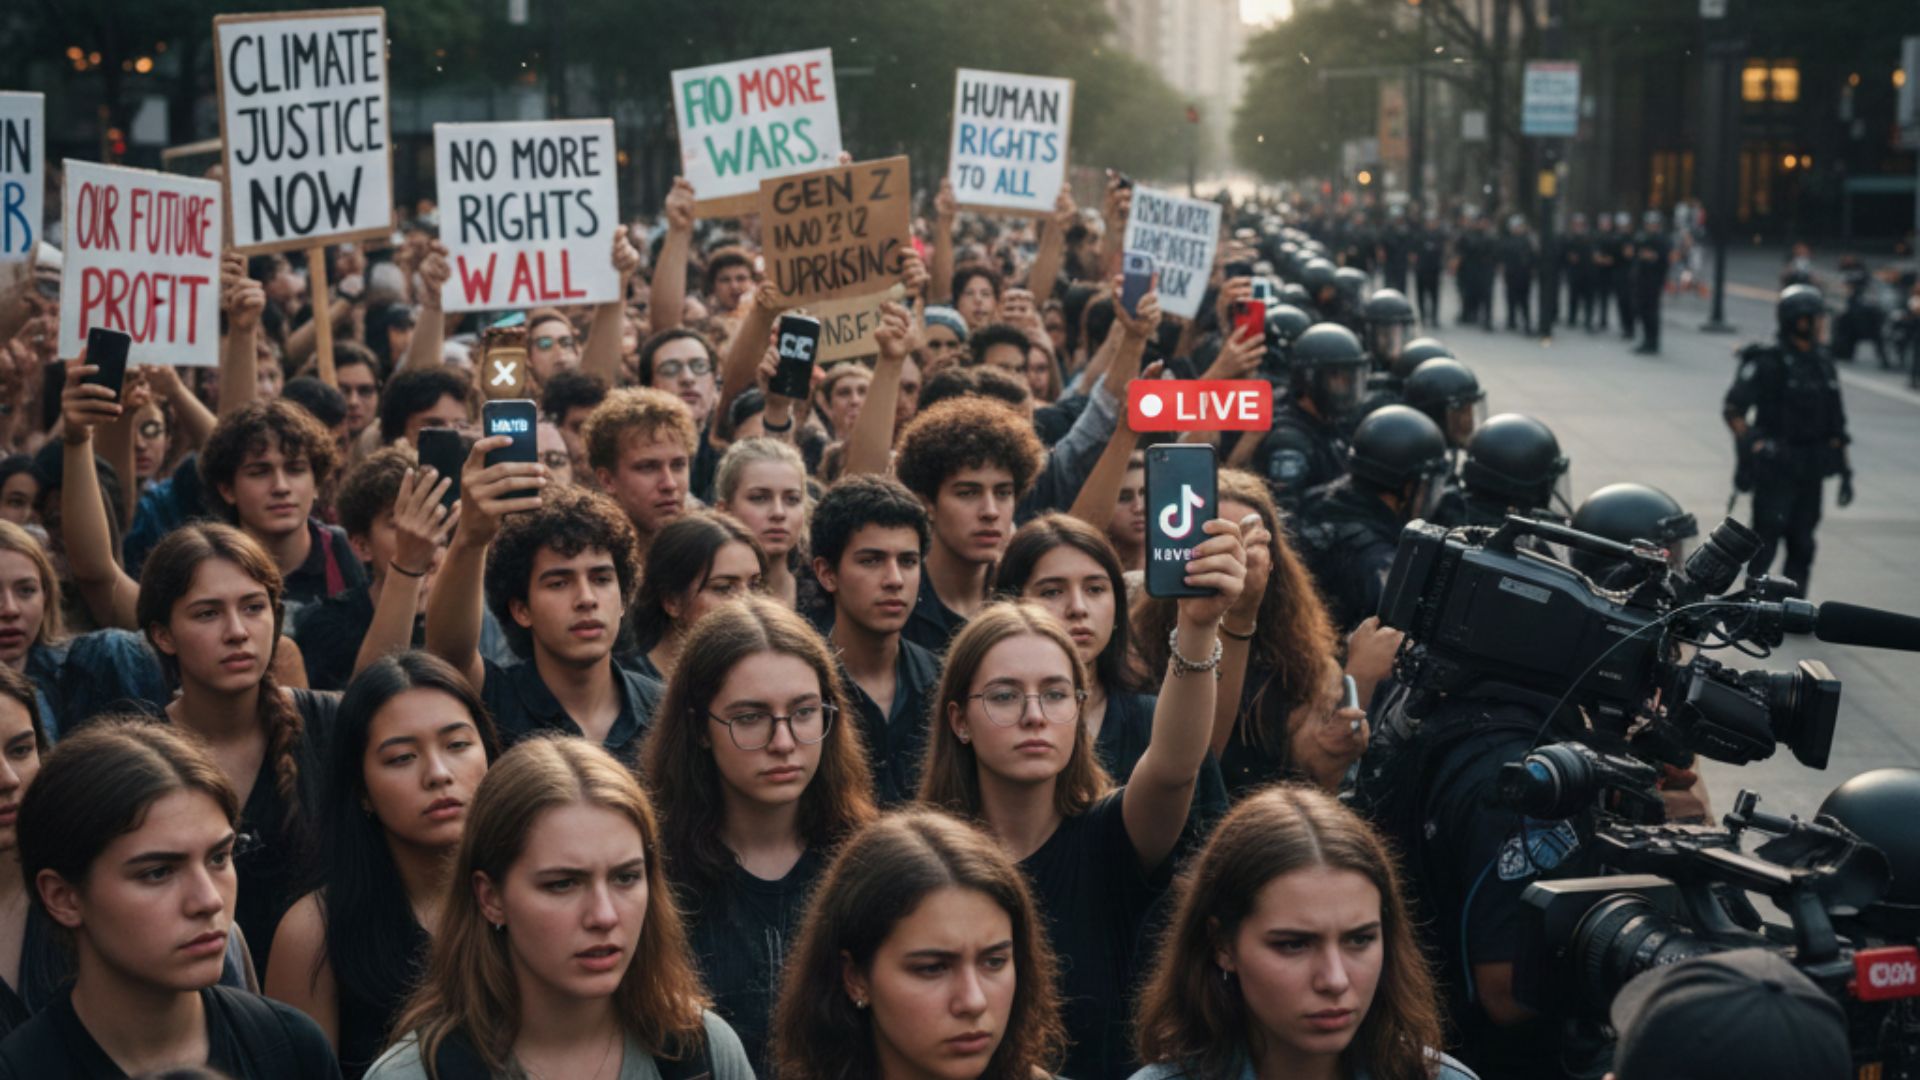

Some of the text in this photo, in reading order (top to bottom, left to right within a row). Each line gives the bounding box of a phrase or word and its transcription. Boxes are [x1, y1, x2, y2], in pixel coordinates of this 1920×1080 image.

[228, 28, 380, 97] CLIMATE
[738, 61, 825, 115] MORE
[235, 95, 383, 165] JUSTICE
[960, 81, 1060, 124] HUMAN
[0, 118, 31, 174] N
[449, 136, 601, 182] NO MORE
[958, 123, 1059, 164] RIGHTS
[249, 166, 362, 241] NOW
[772, 168, 892, 215] GEN Z
[957, 164, 1036, 198] TO ALL
[76, 181, 215, 259] OUR FUTURE
[458, 188, 599, 244] RIGHTS
[775, 237, 905, 297] UPRISING
[78, 266, 209, 346] PROFIT
